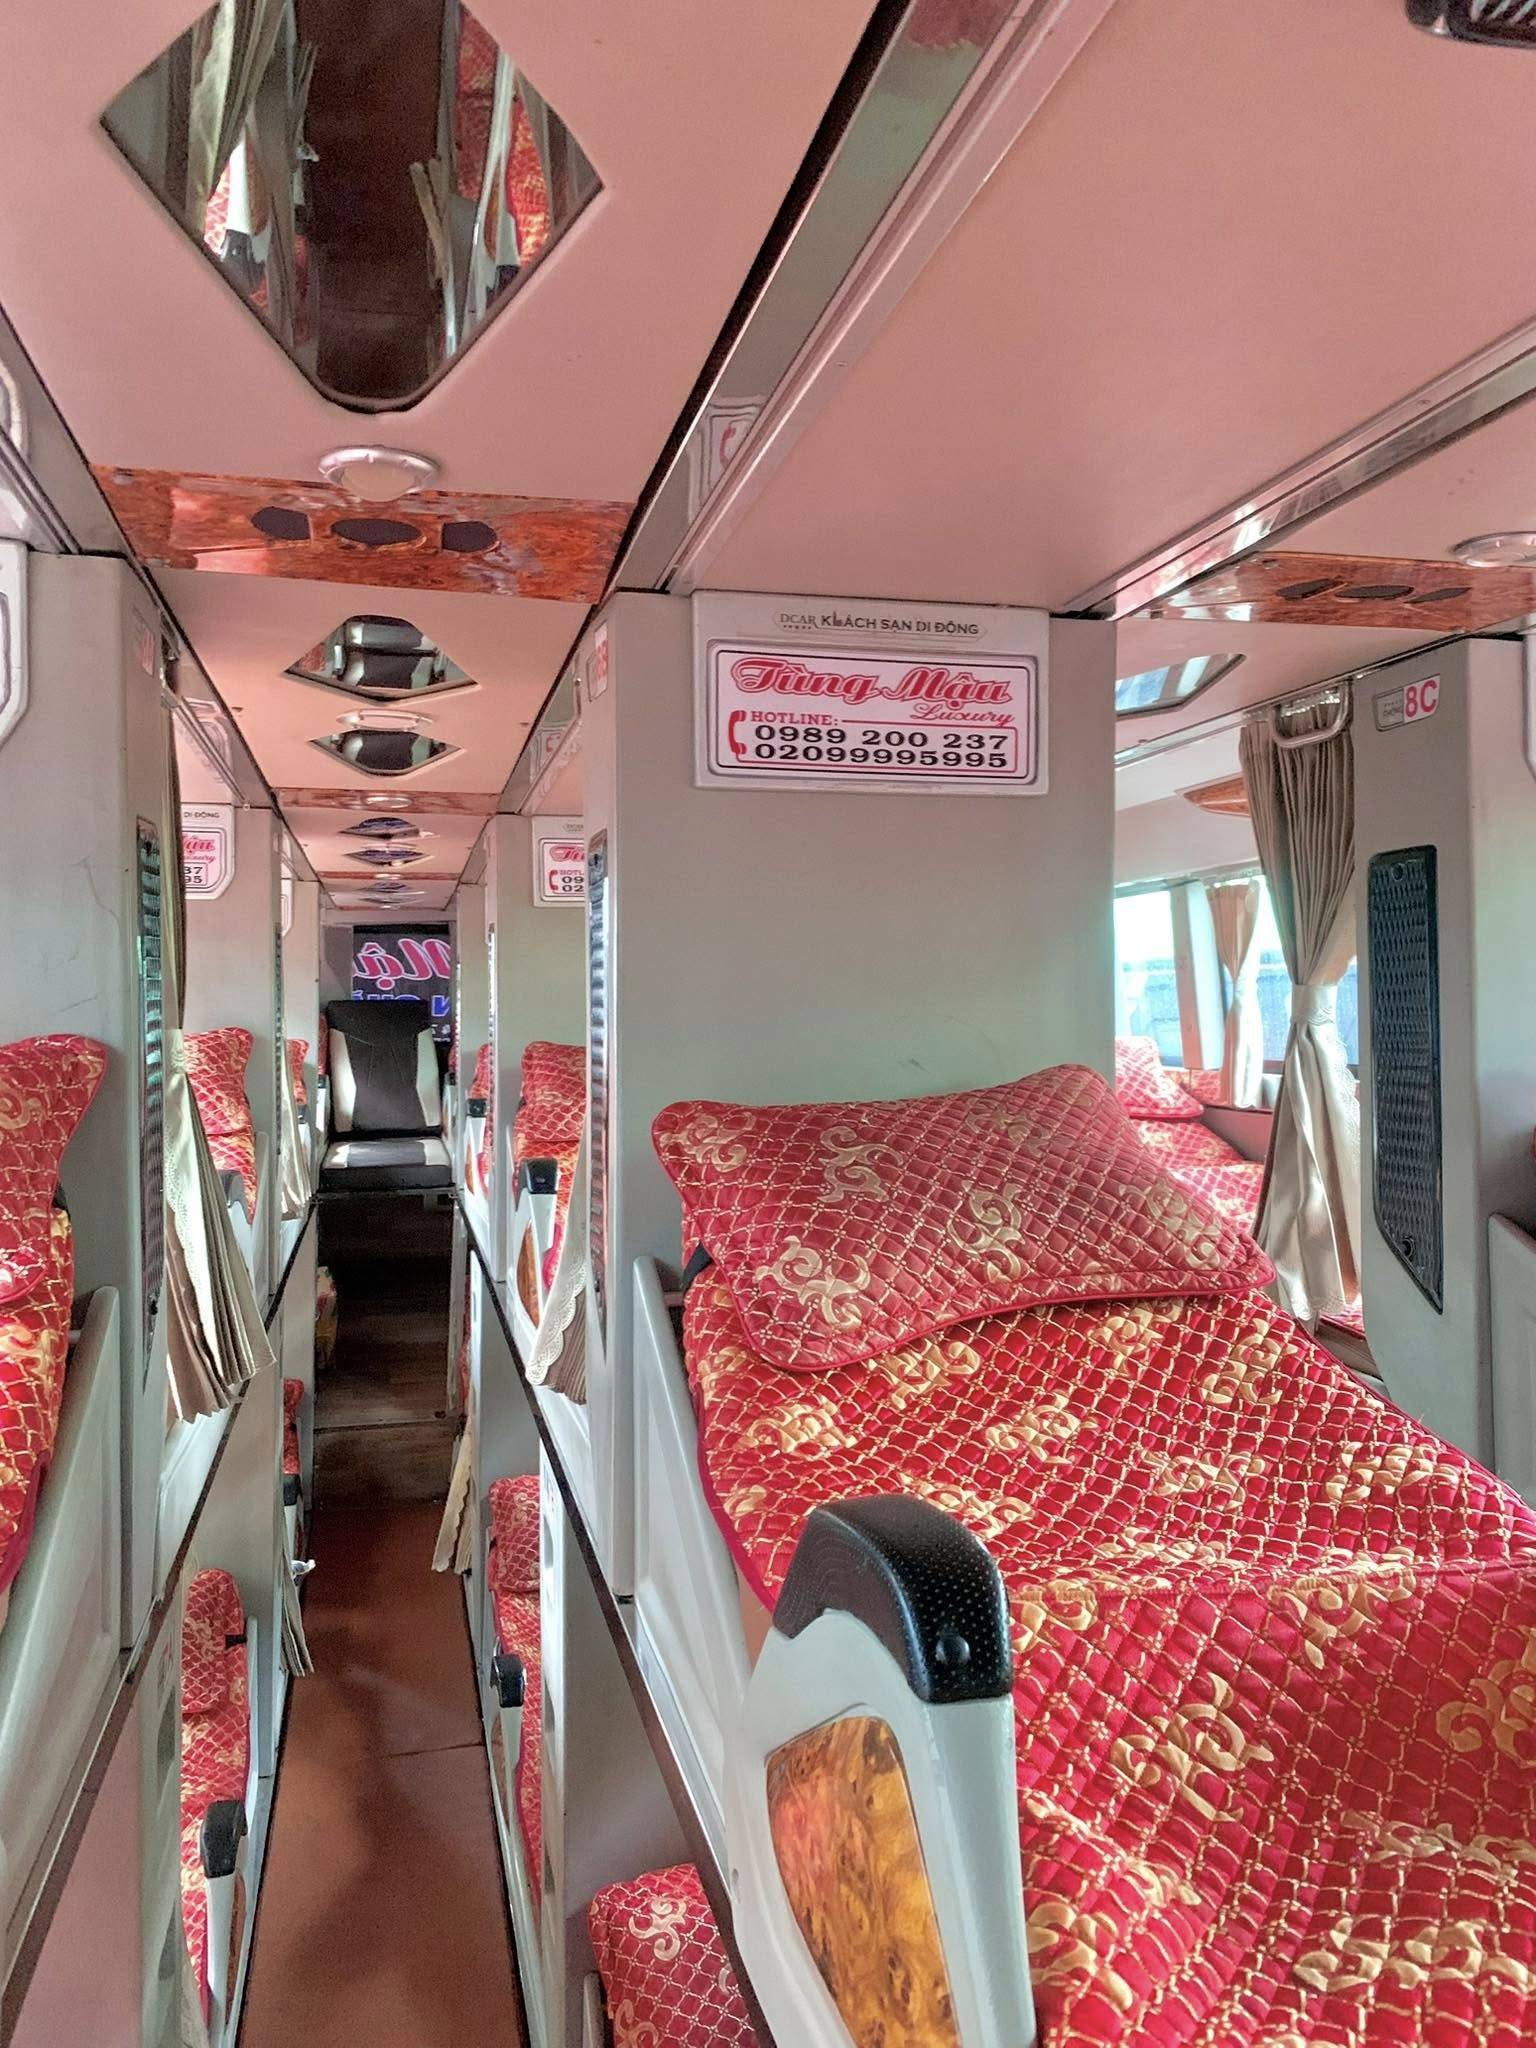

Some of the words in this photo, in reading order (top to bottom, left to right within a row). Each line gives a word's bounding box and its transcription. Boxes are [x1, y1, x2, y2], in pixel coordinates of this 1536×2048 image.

[780, 613, 818, 629] DCAR
[916, 622, 932, 634] DI
[731, 657, 880, 705] Tùng
[880, 666, 1013, 710] Mậu
[1405, 680, 1437, 717] 8C
[751, 711, 839, 726] HOTLINE:
[910, 702, 1015, 727] Luxury
[755, 724, 847, 744] 0989
[861, 729, 928, 747] 200
[943, 734, 1009, 750] 237
[755, 743, 1008, 768] 02099995995
[183, 836, 215, 854] ậu
[183, 867, 203, 875] 37
[562, 876, 584, 884] 09
